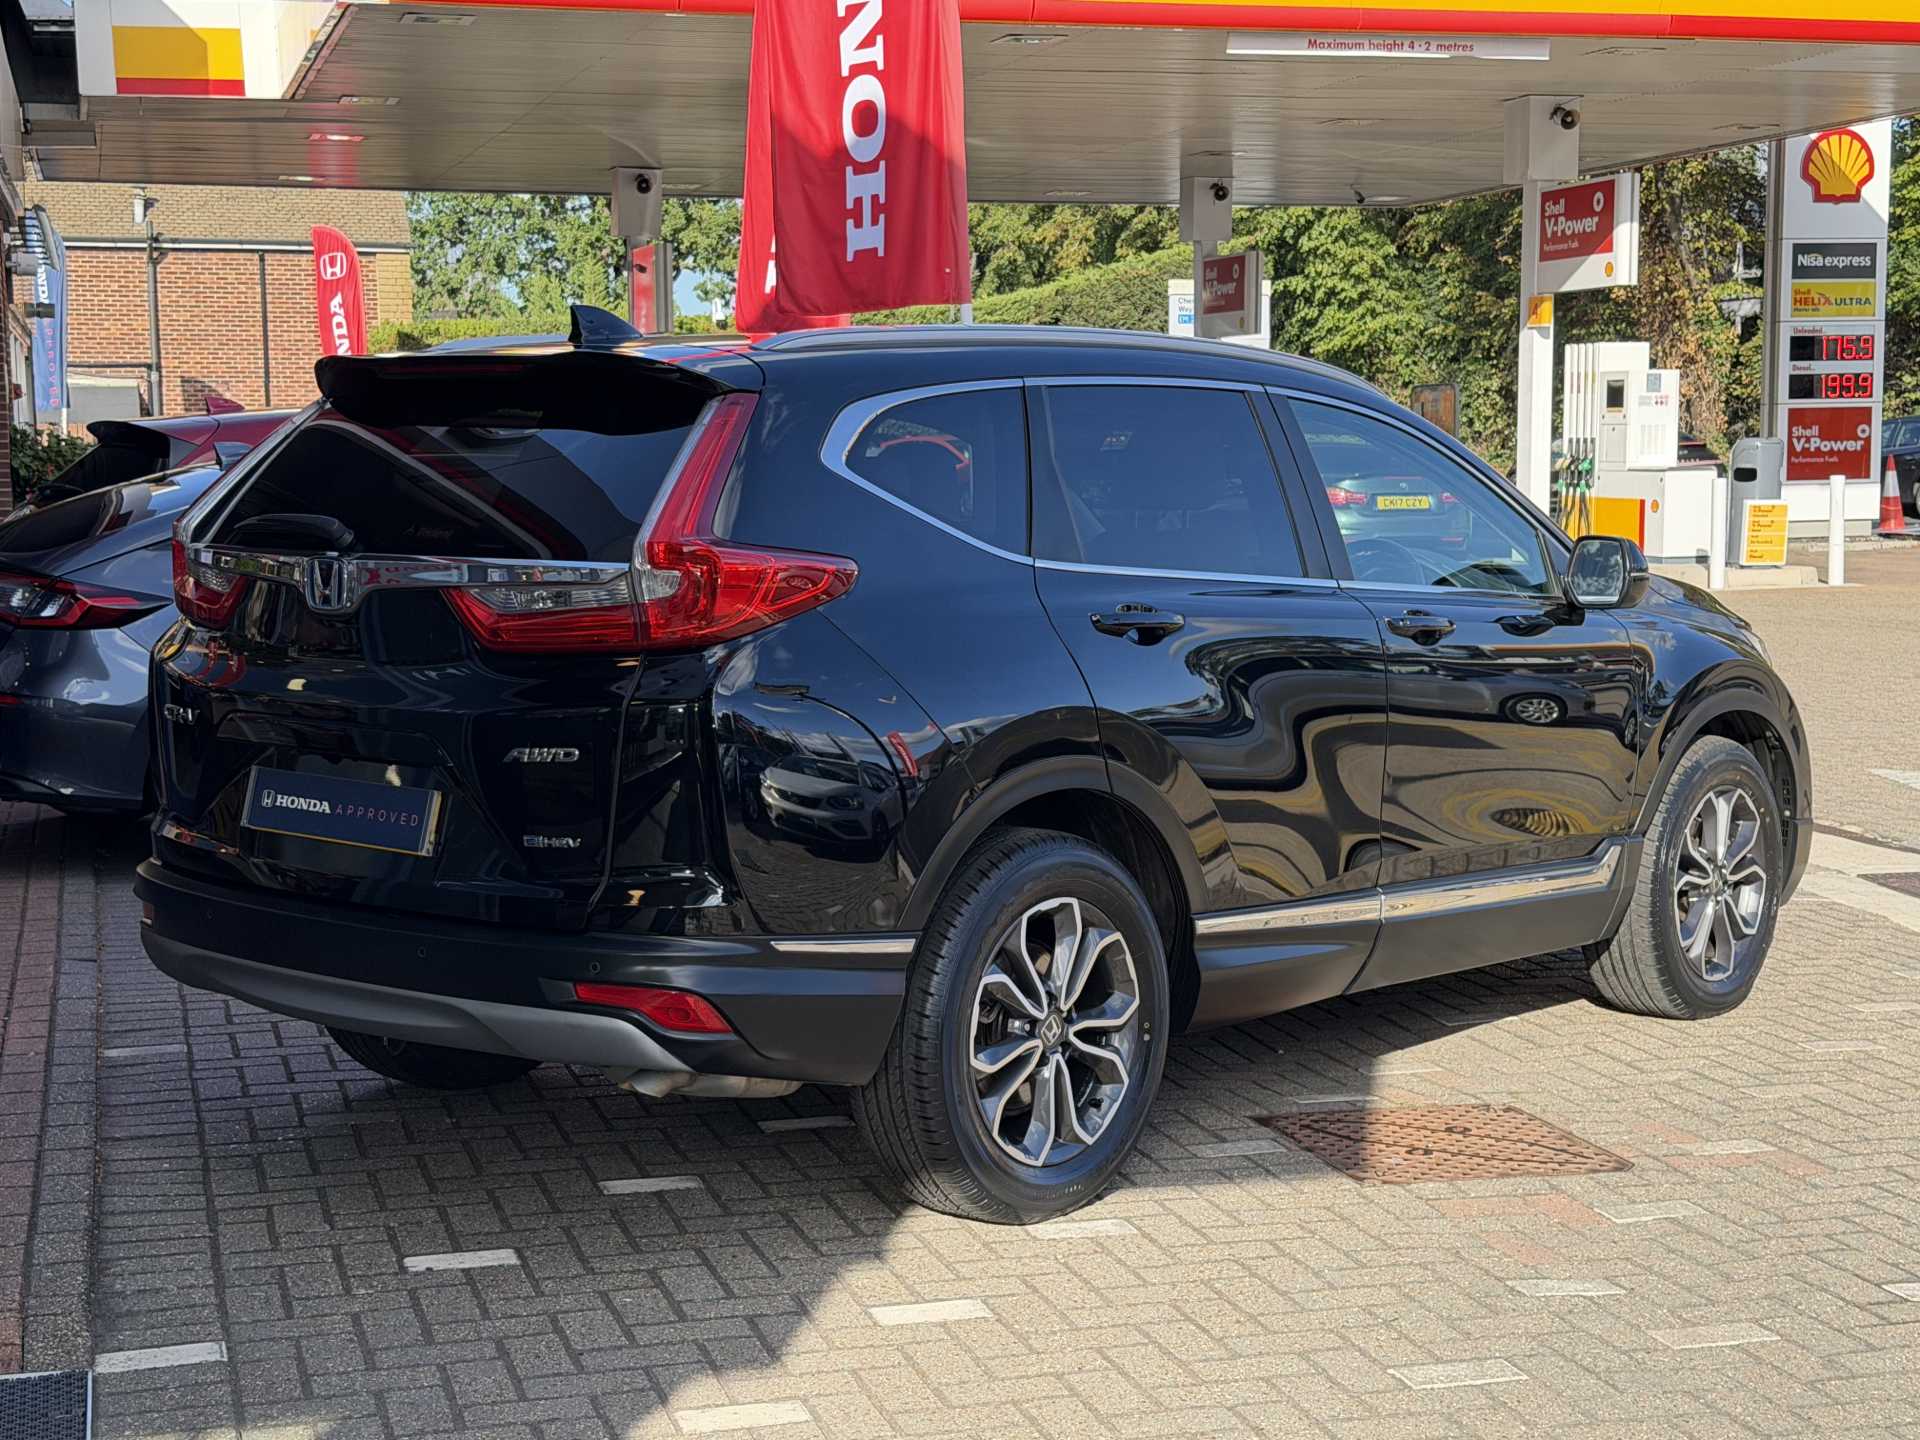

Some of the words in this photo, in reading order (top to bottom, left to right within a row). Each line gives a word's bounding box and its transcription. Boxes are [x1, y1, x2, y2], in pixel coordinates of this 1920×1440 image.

[1307, 38, 1365, 50] Maximum
[1368, 39, 1404, 53] height
[1435, 42, 1474, 52] metres
[1544, 198, 1565, 217] Shell
[1544, 215, 1599, 239] V-Power
[1793, 295, 1833, 307] HELIX
[1834, 297, 1872, 306] ULTRA
[1822, 335, 1873, 360] 175.9
[1821, 373, 1873, 399] 199.9
[1792, 425, 1819, 437] Shell
[1792, 437, 1865, 452] V-Power
[502, 747, 580, 763] AWD
[275, 793, 331, 814] HONDA
[335, 804, 419, 826] APPROVED
